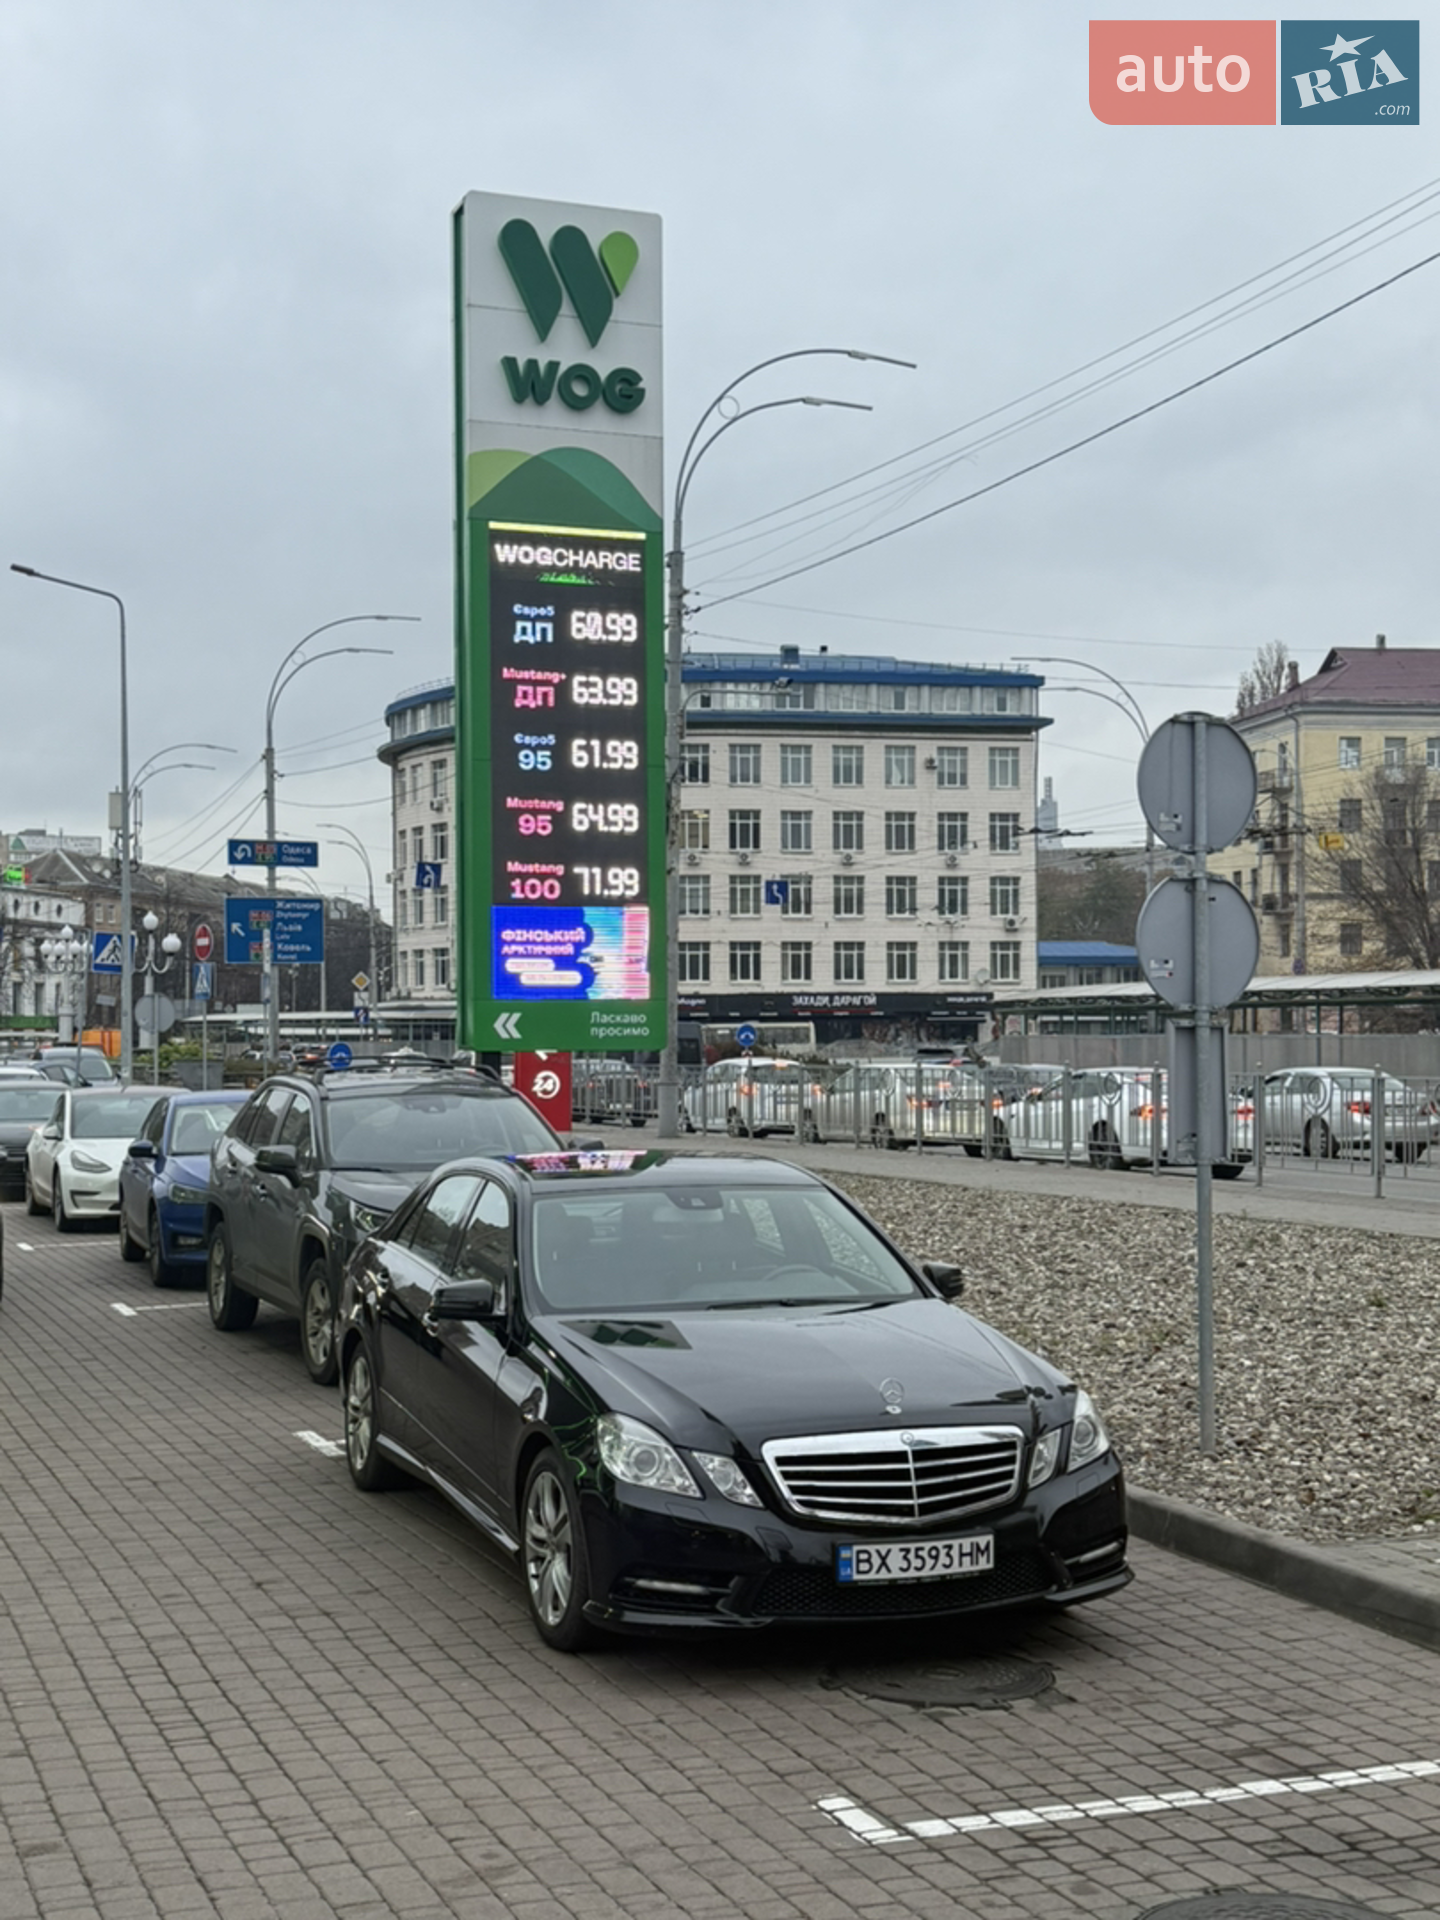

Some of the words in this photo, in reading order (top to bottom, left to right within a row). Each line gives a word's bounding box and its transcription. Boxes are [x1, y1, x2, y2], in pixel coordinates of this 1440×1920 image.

[500, 356, 646, 414] WOG
[513, 620, 554, 644] ДП
[570, 610, 638, 642] 60.99
[514, 685, 555, 709] ДП
[571, 675, 638, 706] 63.99
[517, 750, 552, 771] 95
[571, 739, 639, 770] 61.99
[506, 797, 564, 812] Mustang
[517, 815, 553, 836] 95
[572, 803, 639, 833] 64.99
[506, 861, 564, 876] Mustang
[510, 879, 561, 900] 100
[572, 867, 639, 897] 71.99
[275, 901, 321, 912] Житомир
[501, 927, 586, 943] ФІНСЬКИЙ
[590, 1010, 647, 1025] Ласкаво
[590, 1024, 651, 1038] просимо
[898, 1543, 955, 1573] 3593
